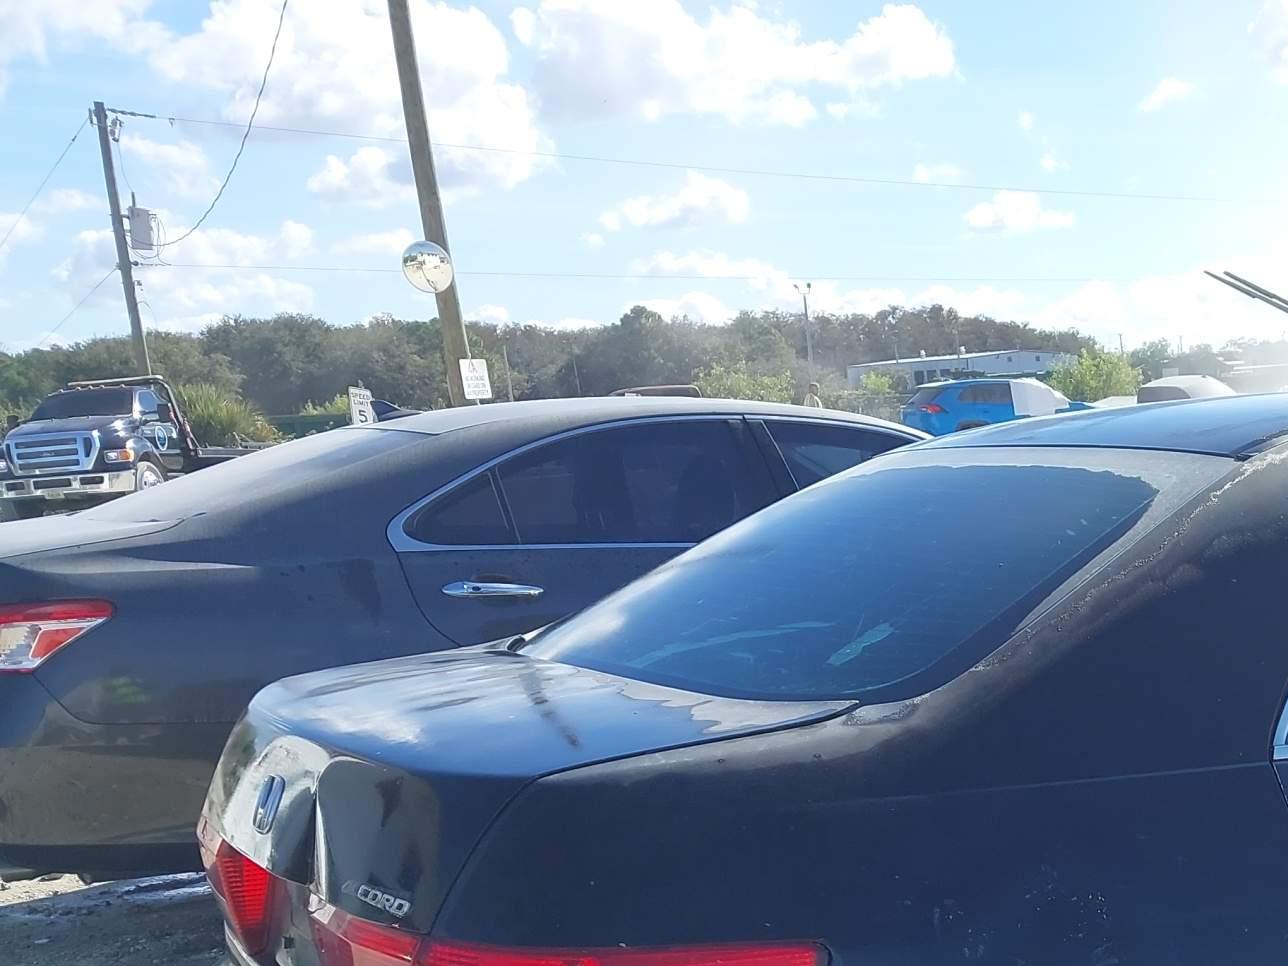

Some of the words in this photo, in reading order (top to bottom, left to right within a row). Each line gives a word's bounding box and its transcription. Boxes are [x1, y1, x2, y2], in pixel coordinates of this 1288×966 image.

[351, 391, 370, 400] SPEED
[353, 399, 369, 407] LIMIT
[359, 409, 369, 423] 5
